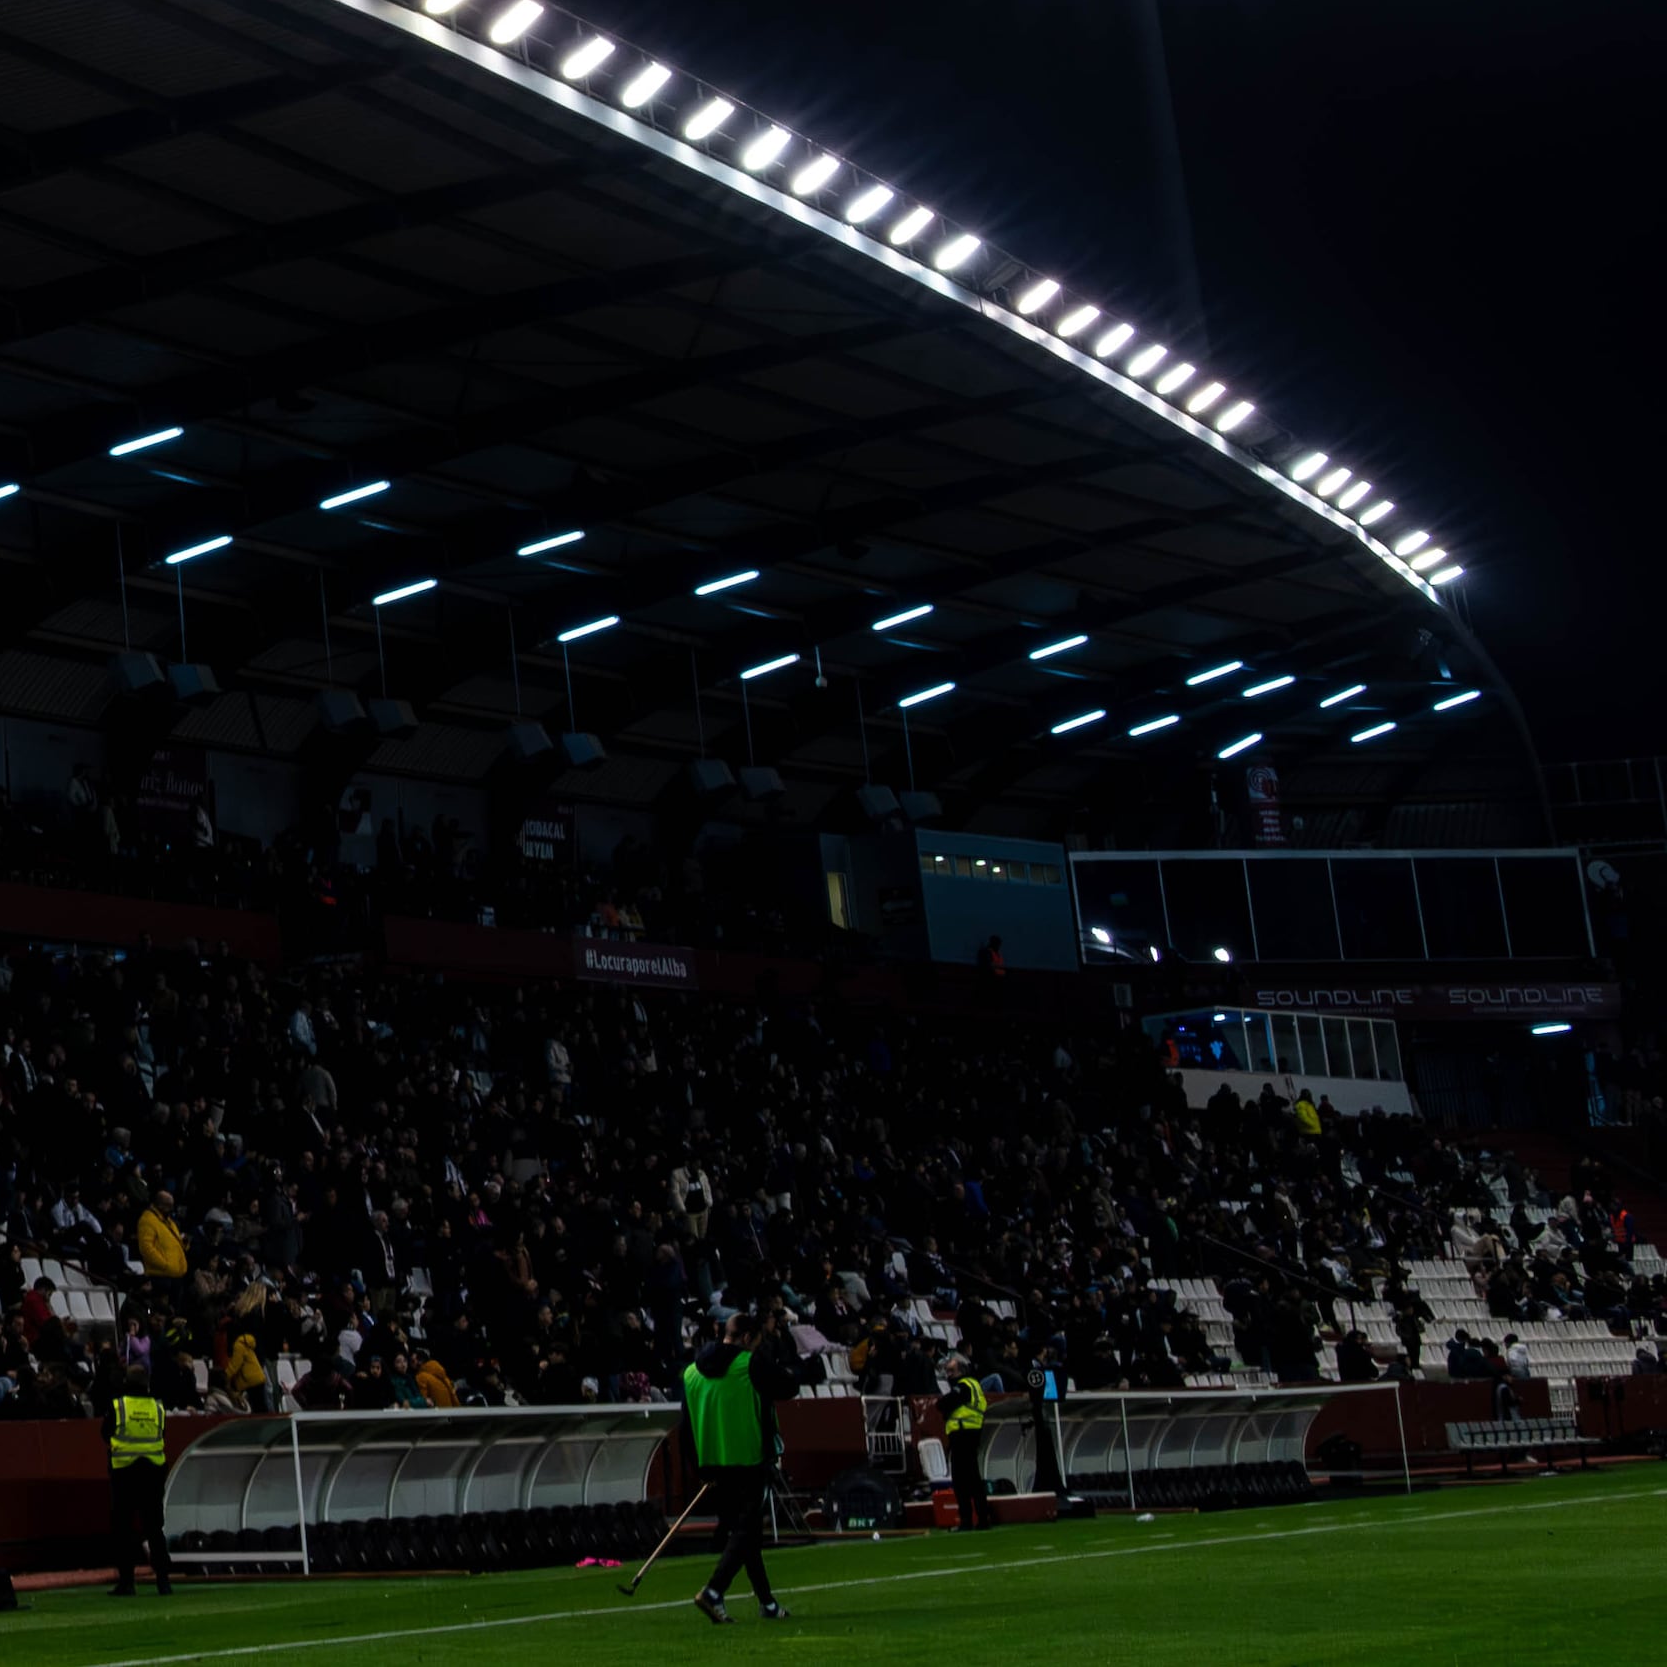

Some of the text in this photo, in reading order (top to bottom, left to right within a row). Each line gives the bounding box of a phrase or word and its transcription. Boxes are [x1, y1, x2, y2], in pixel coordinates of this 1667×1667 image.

[585, 948, 688, 979] #LocuraporelAlba
[1256, 988, 1414, 1007] SOUNDLINE
[1448, 987, 1604, 1005] SOUNDLINE
